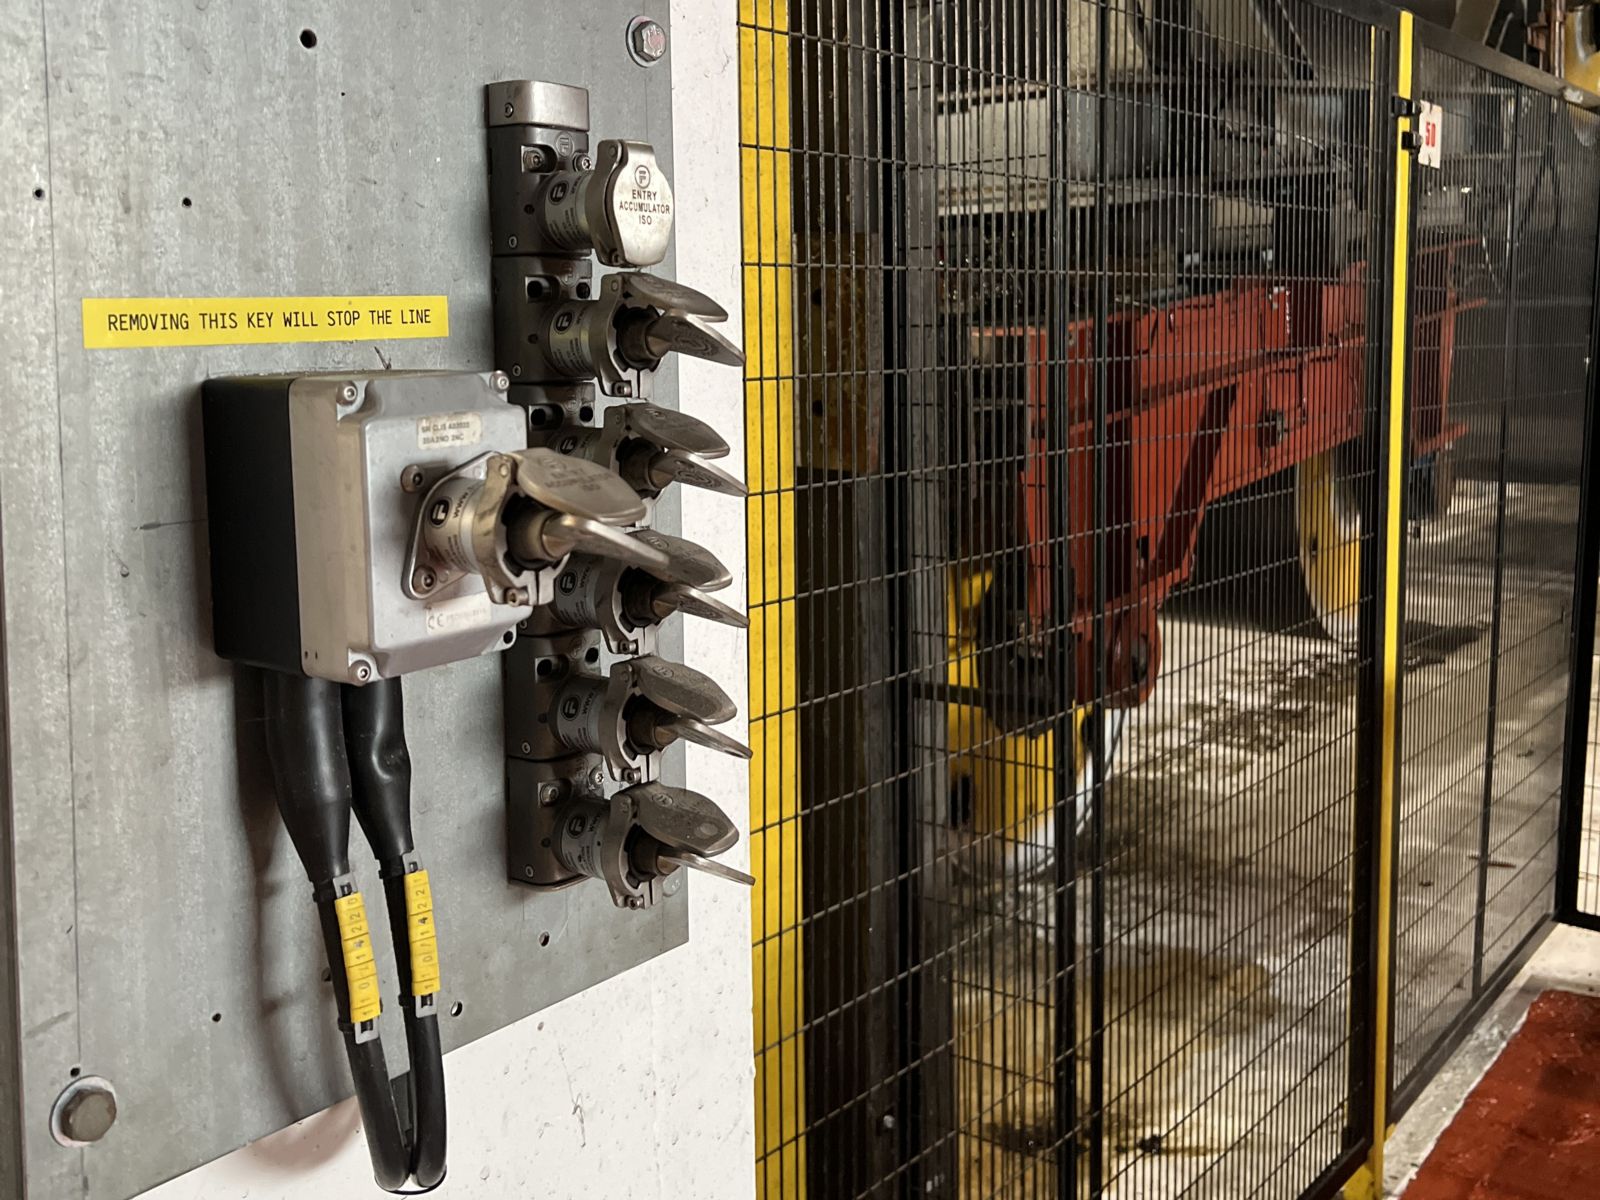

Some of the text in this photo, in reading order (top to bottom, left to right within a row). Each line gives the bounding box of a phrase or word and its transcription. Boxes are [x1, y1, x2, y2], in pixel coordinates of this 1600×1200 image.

[1425, 121, 1436, 148] 50
[632, 189, 657, 201] ENTRY
[619, 200, 671, 215] ACCUMULATOR
[639, 214, 653, 225] ISO
[107, 309, 432, 331] REMOVING THIS KEY WILL STOP THE LINE
